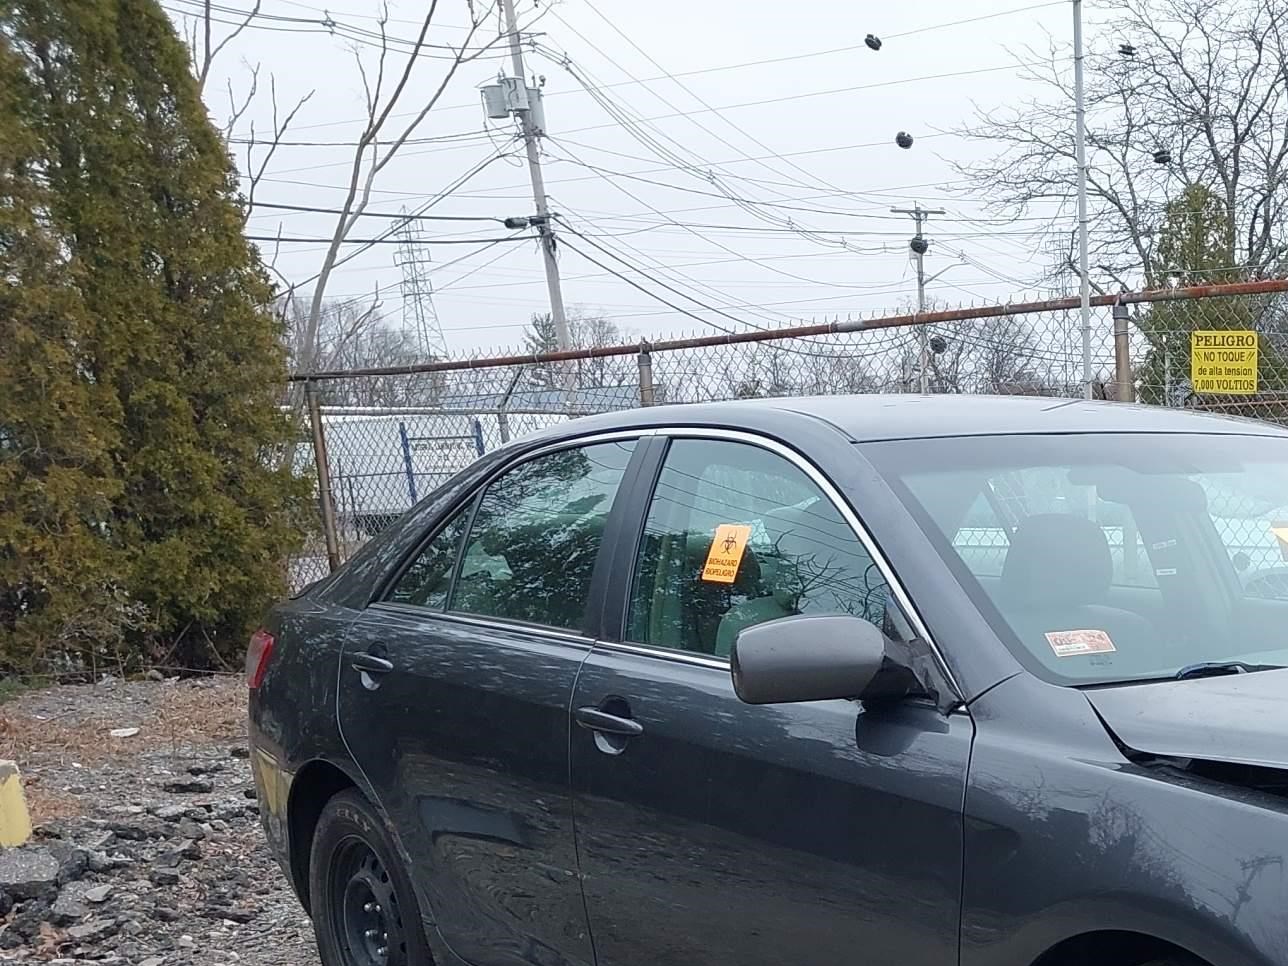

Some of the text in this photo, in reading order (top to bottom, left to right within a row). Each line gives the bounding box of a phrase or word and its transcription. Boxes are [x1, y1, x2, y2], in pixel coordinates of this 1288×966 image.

[1195, 335, 1255, 347] PELIGRO
[1203, 351, 1246, 362] NO TOQUE
[1198, 366, 1253, 376] de alta tension
[1195, 379, 1255, 391] 7,000 VOLTIOS
